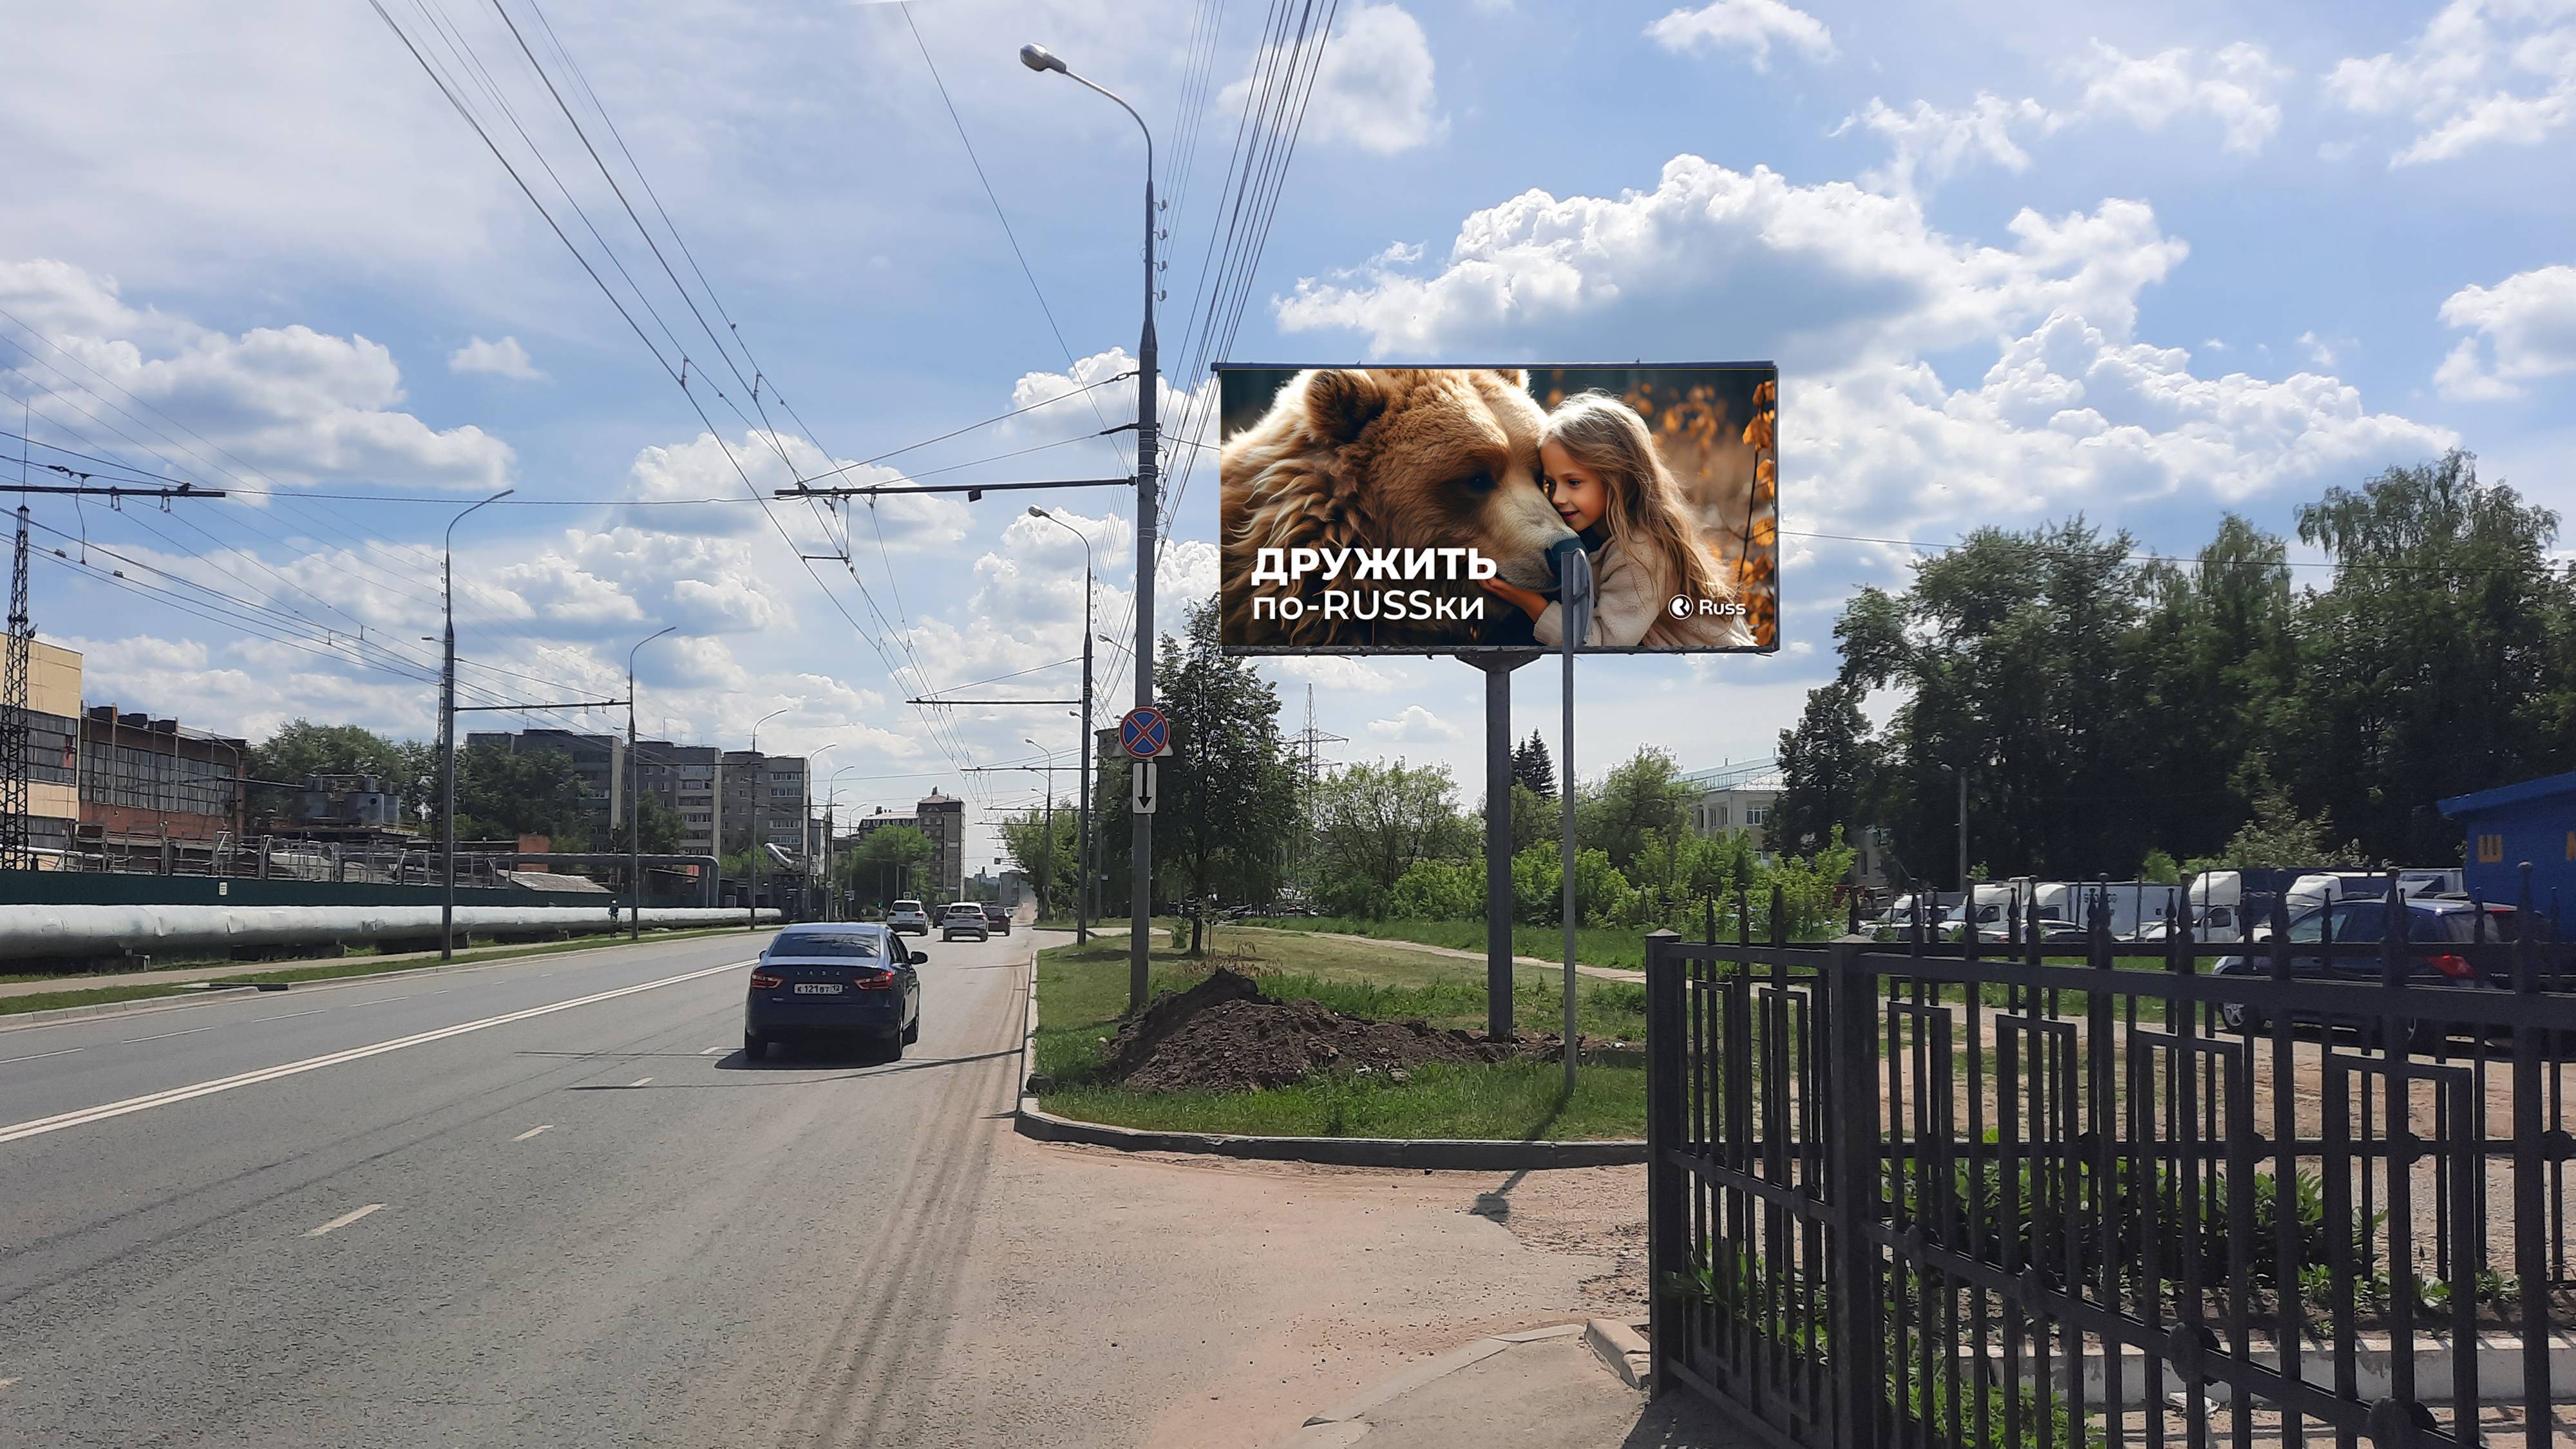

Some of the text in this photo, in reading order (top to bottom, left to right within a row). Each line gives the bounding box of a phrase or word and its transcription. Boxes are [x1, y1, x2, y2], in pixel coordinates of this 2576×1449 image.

[1251, 547, 1497, 586] ДРУЖИТЬ
[1253, 589, 1484, 620] по-RUSSки
[1700, 599, 1746, 615] Russ
